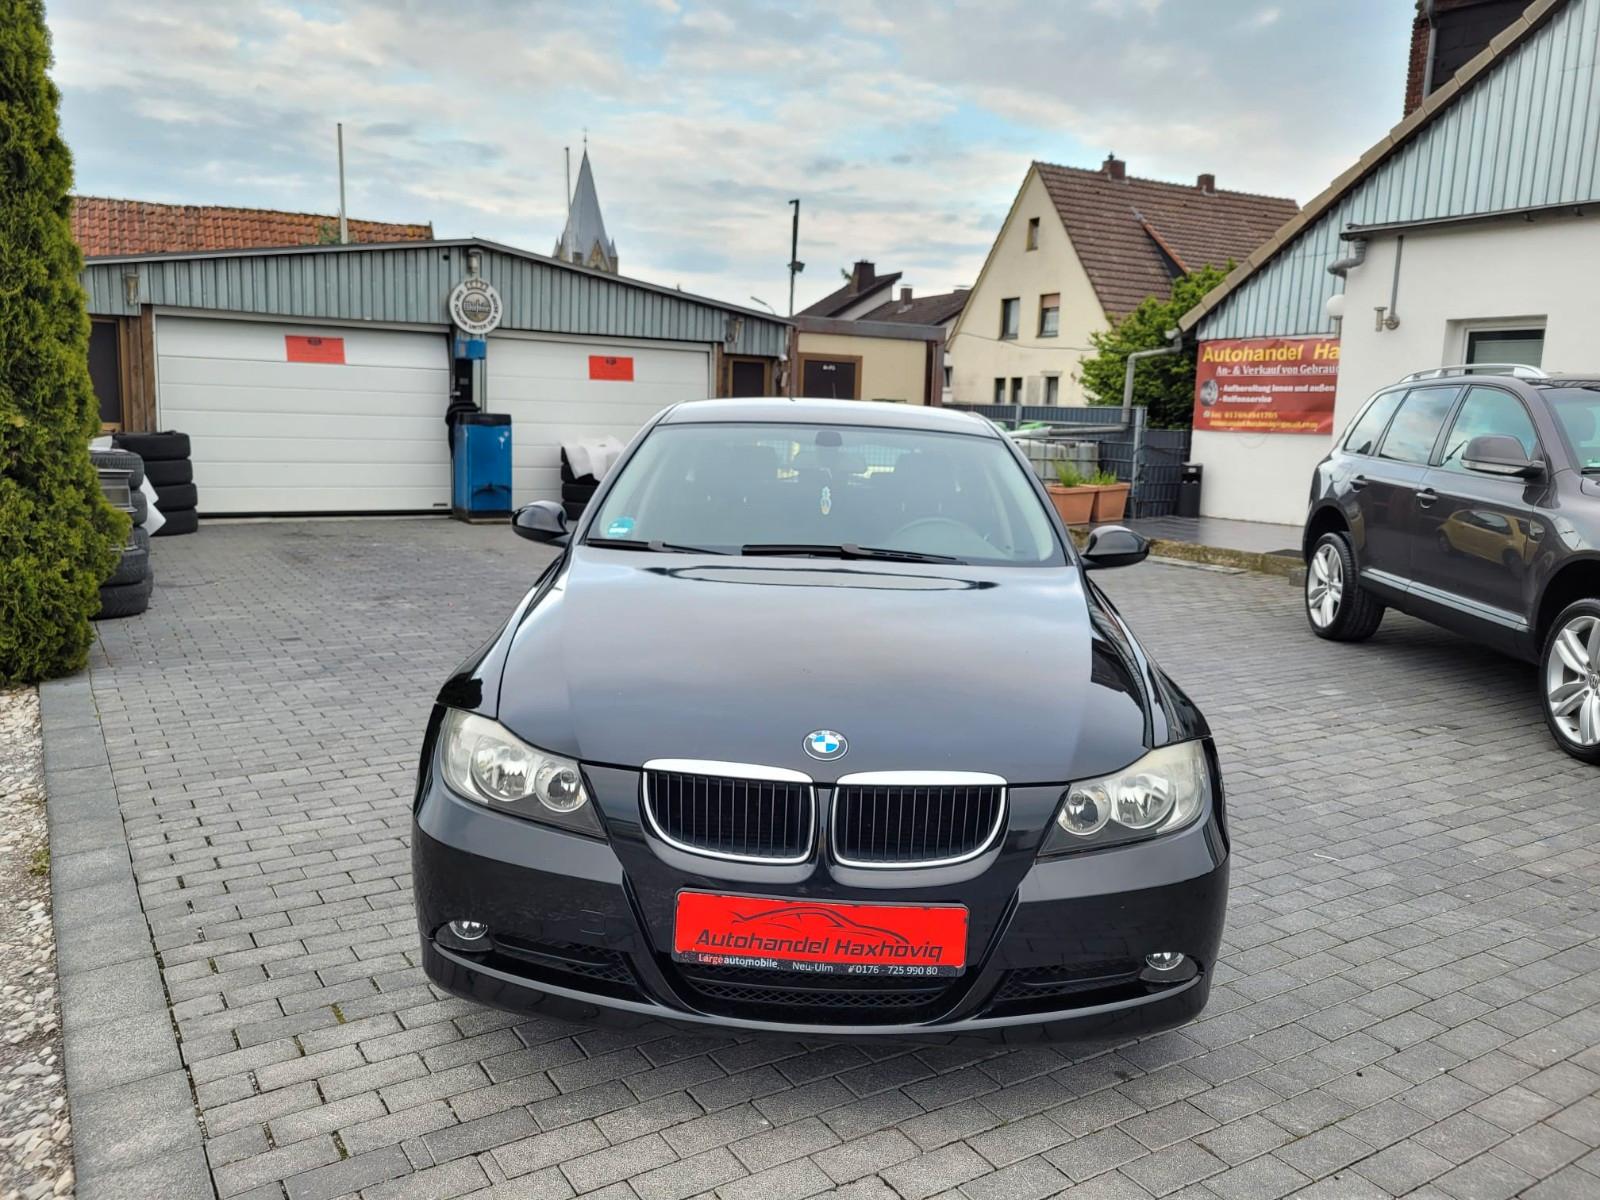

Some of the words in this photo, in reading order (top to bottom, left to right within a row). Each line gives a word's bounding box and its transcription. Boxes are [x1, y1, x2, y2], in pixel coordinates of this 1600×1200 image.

[1202, 344, 1304, 362] Autohandel
[1242, 364, 1281, 375] Verkauf
[1281, 366, 1298, 374] von
[696, 929, 829, 954] Autohandel
[792, 961, 834, 973] Neu-Ulm
[856, 966, 879, 974] 0176
[888, 966, 904, 975] 725
[907, 966, 924, 975] 990
[926, 966, 938, 975] 80
